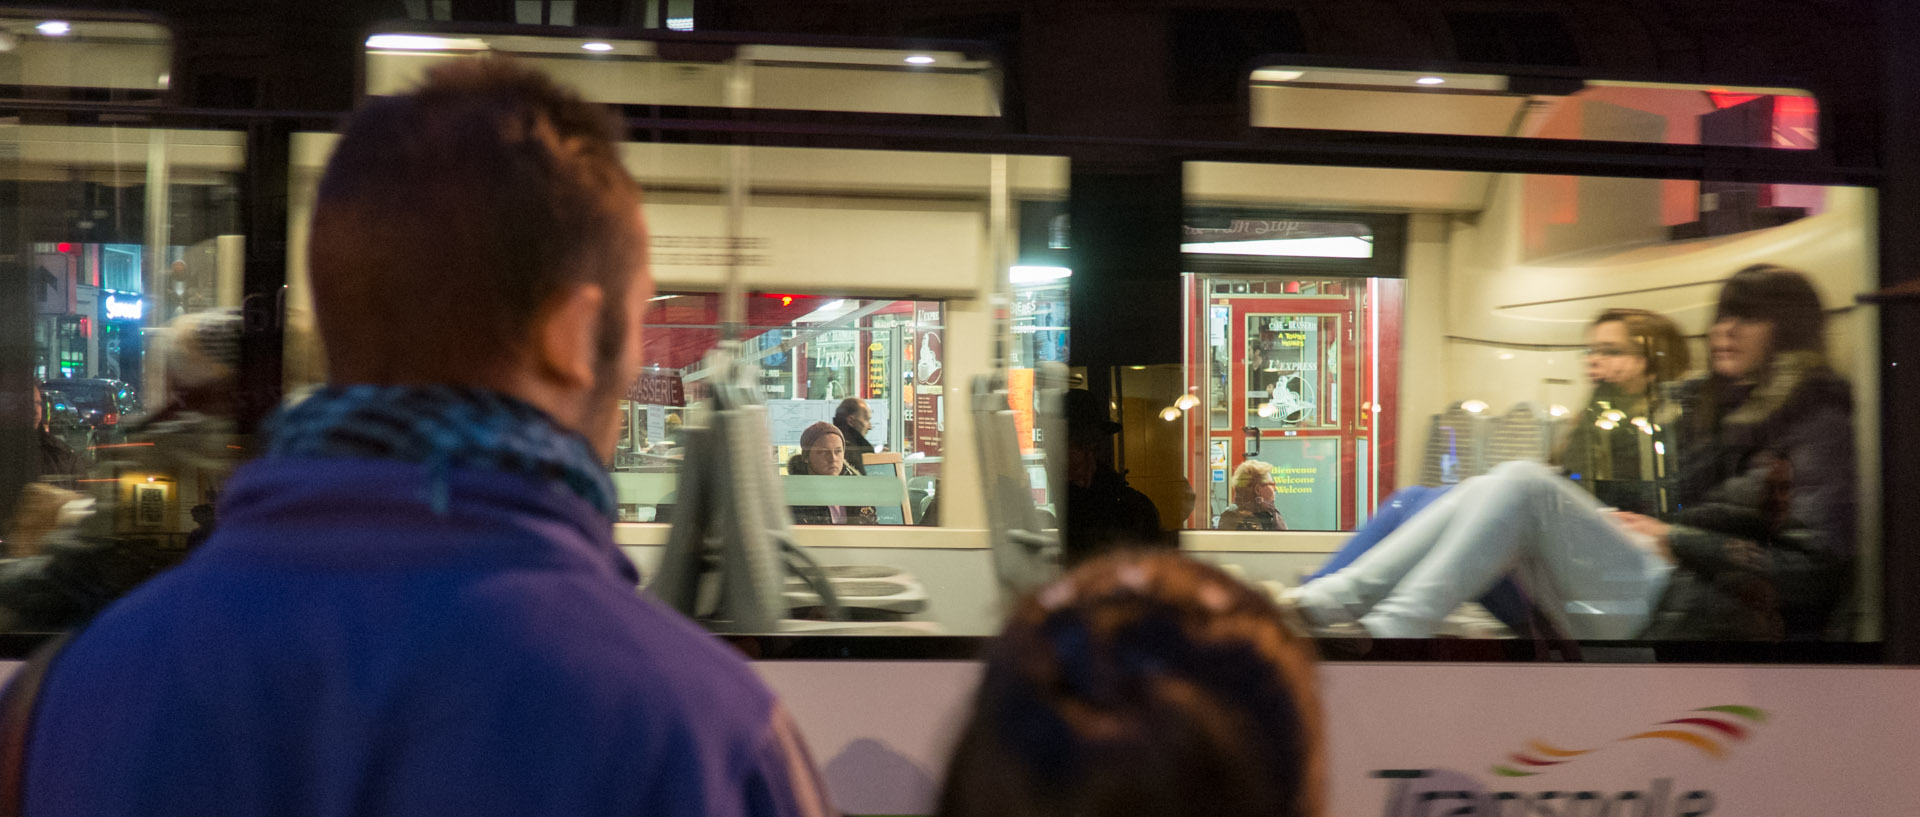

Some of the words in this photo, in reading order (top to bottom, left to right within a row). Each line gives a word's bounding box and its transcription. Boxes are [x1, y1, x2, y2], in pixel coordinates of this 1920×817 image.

[1269, 359, 1318, 371] L'EXPRESS
[1271, 465, 1318, 475] Bienvenue
[1273, 475, 1316, 484] Welcome
[1275, 484, 1313, 494] Welcom
